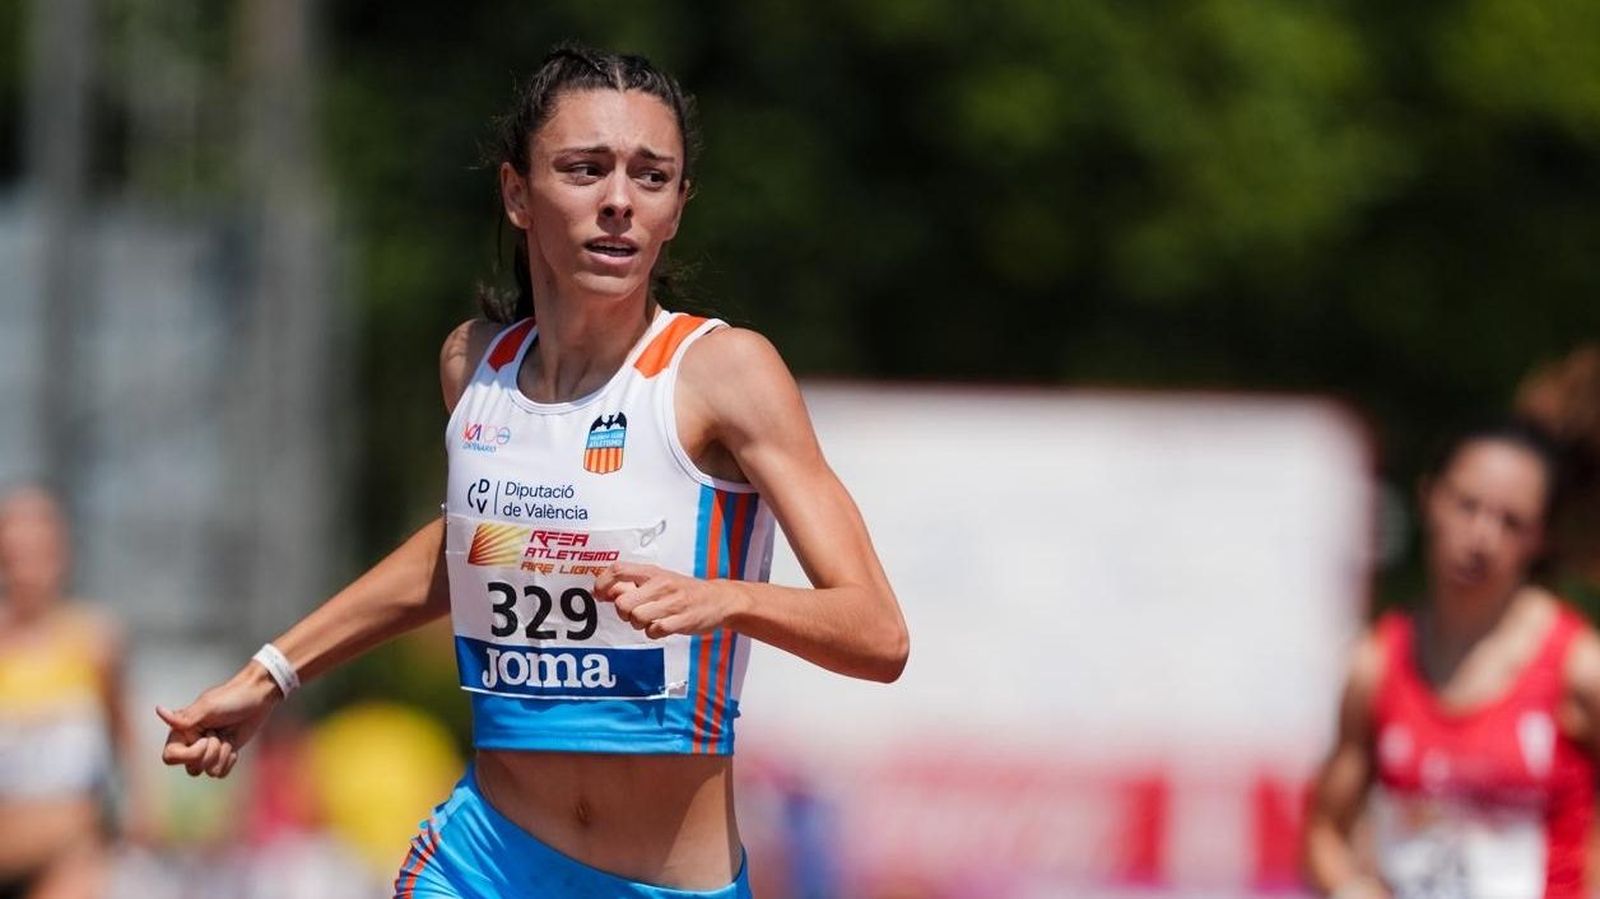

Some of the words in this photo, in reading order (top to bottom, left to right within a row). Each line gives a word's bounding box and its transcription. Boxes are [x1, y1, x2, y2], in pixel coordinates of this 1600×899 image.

[505, 481, 575, 500] Diputació
[502, 502, 522, 517] de
[525, 503, 588, 520] València
[524, 547, 620, 562] ATLETISMO
[487, 582, 599, 641] 329
